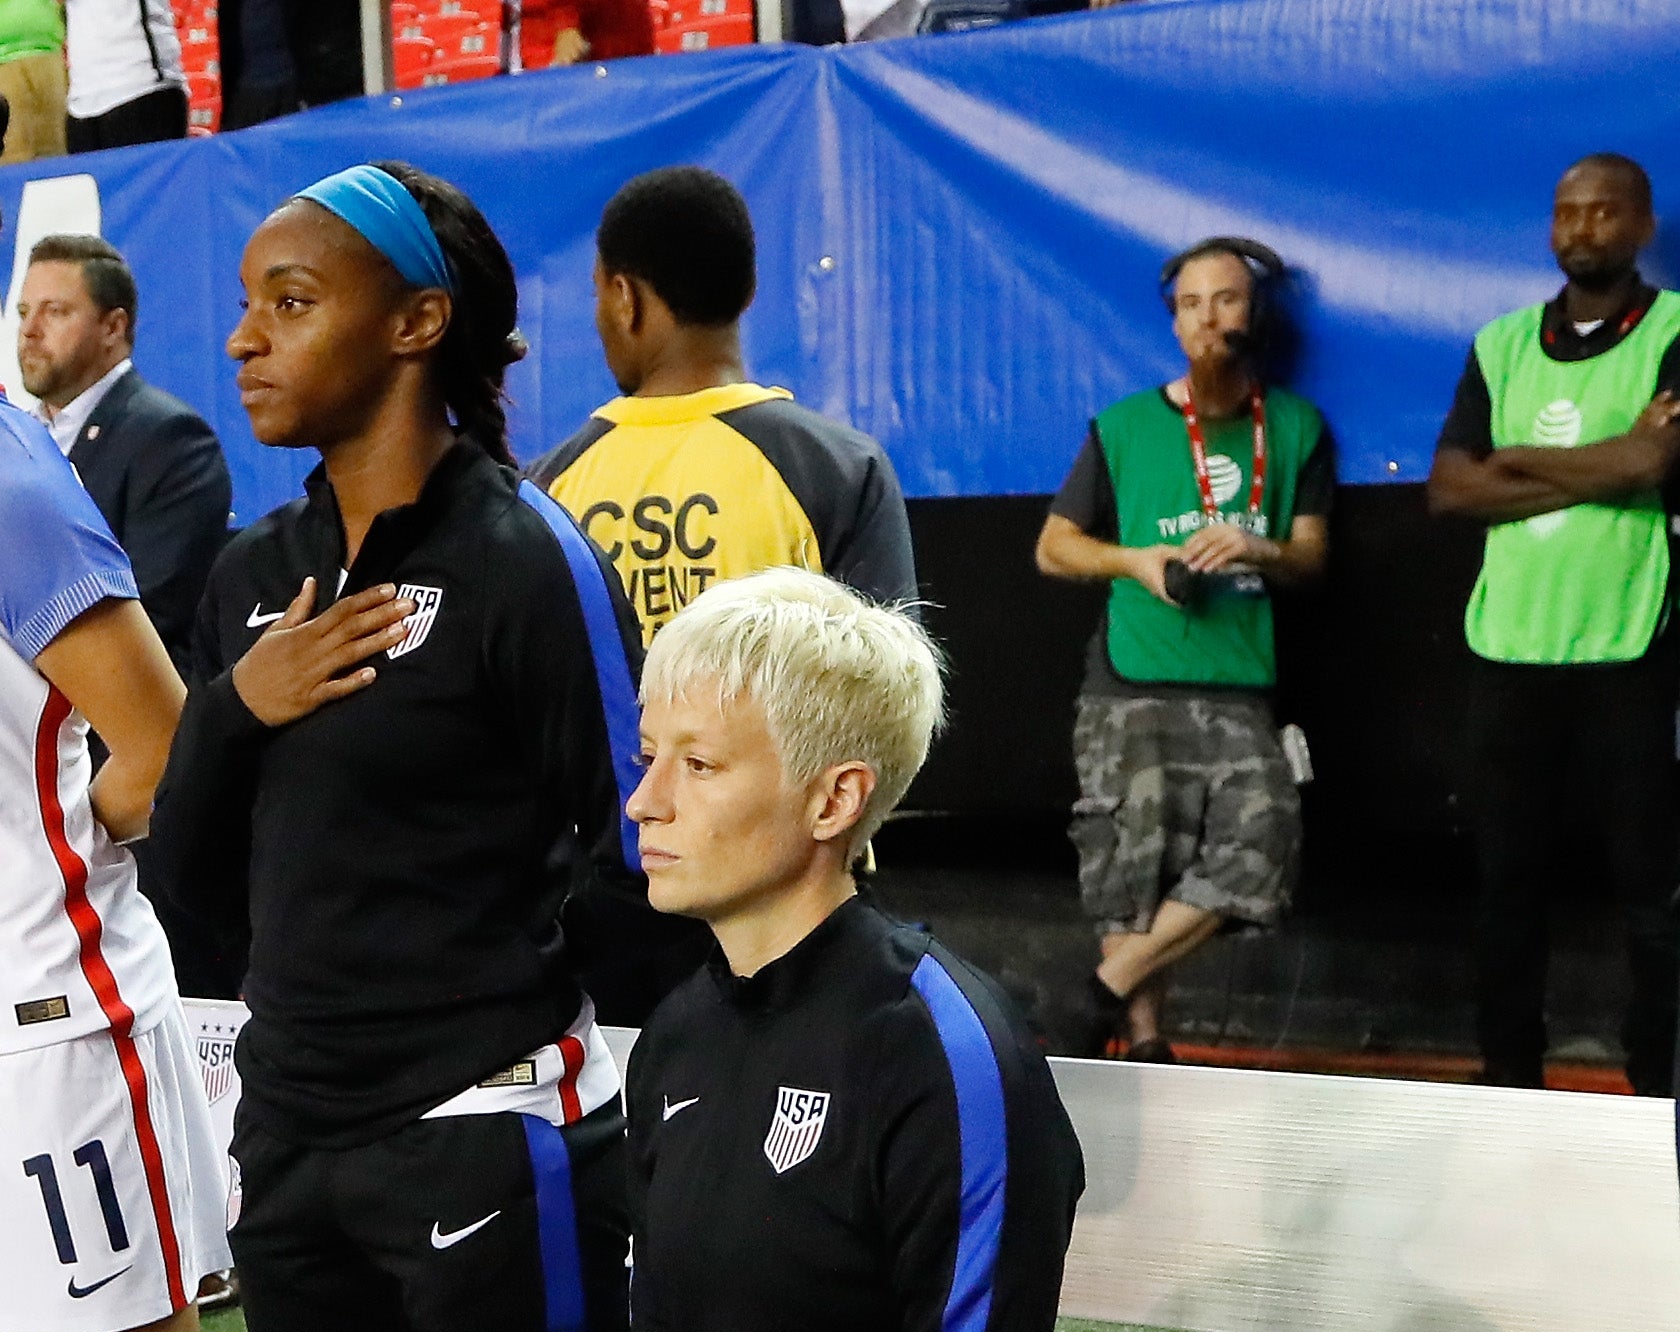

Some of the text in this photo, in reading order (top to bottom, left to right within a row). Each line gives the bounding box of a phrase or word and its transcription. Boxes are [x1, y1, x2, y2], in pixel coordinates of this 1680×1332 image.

[580, 493, 719, 561] CSC
[199, 1042, 233, 1067] USA
[780, 1091, 826, 1125] USA
[23, 1139, 130, 1264] 11
